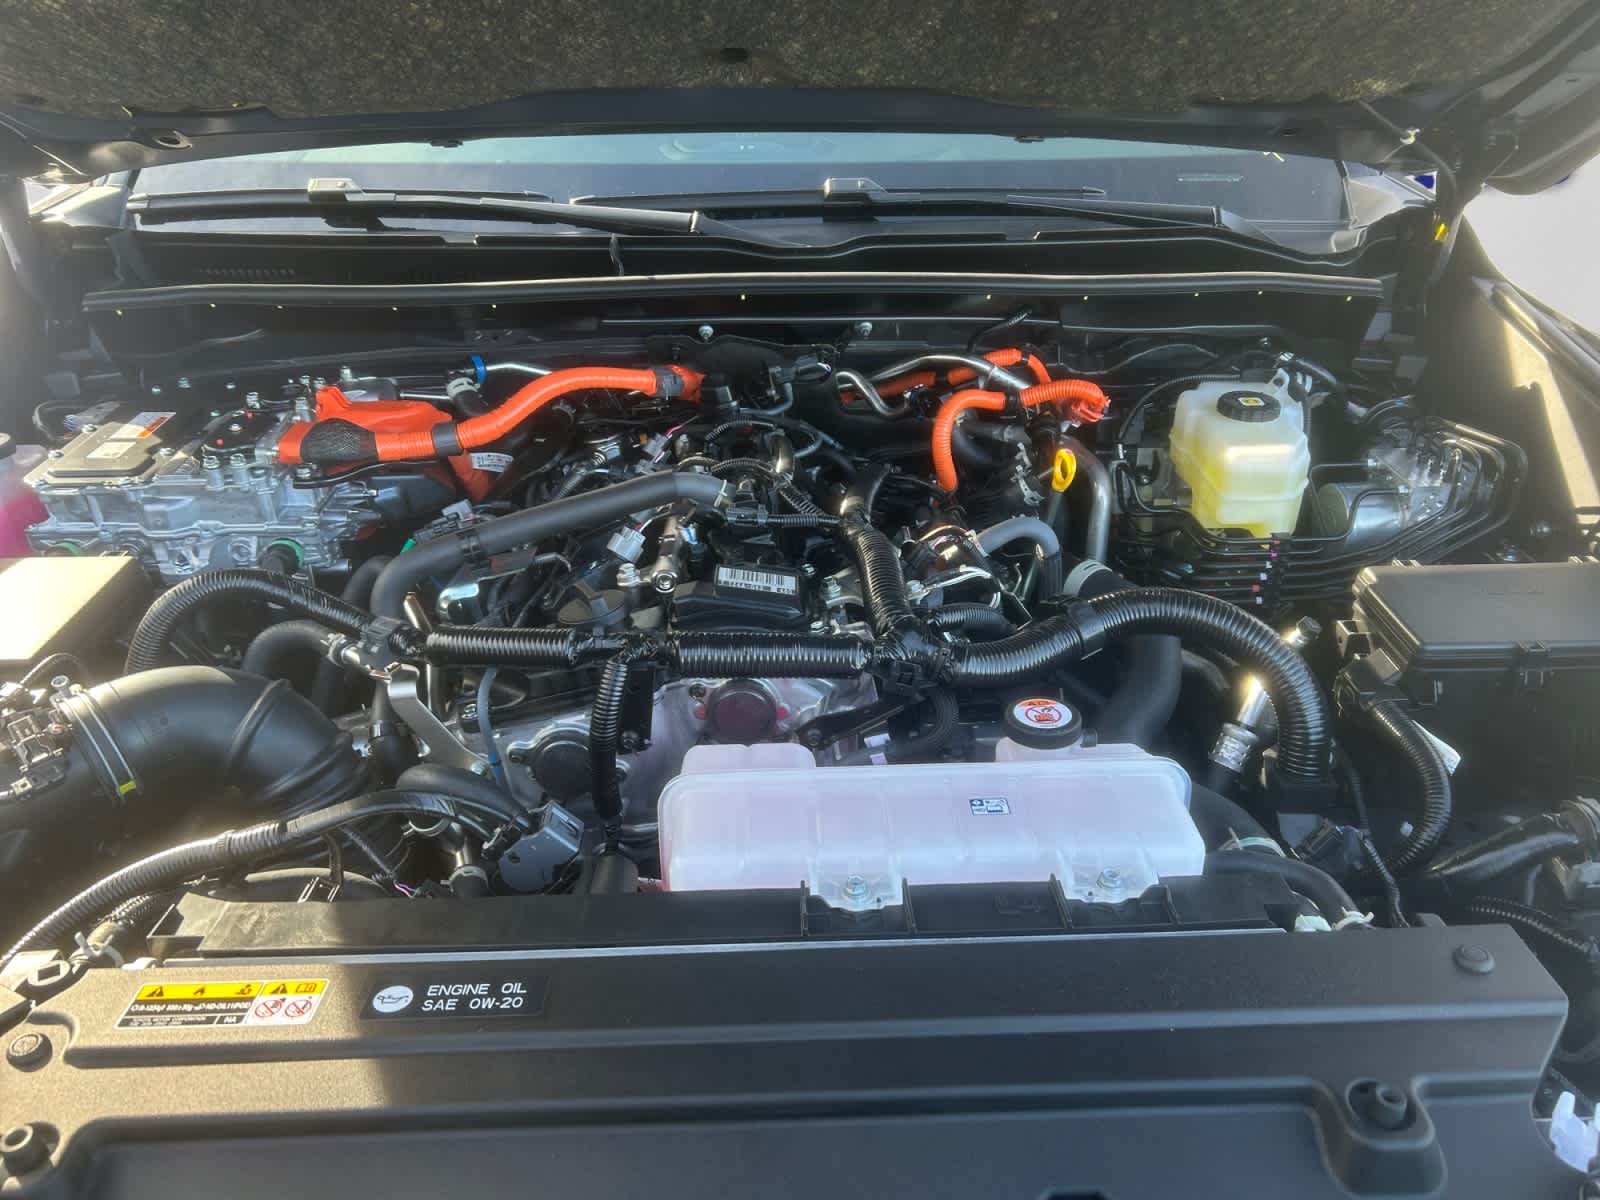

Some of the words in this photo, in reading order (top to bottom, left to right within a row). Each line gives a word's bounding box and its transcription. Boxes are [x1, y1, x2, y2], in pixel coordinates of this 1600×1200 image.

[427, 983, 491, 997] ENGINE
[501, 982, 527, 995] OIL
[421, 998, 459, 1012] SAE
[468, 996, 524, 1010] 0W-20
